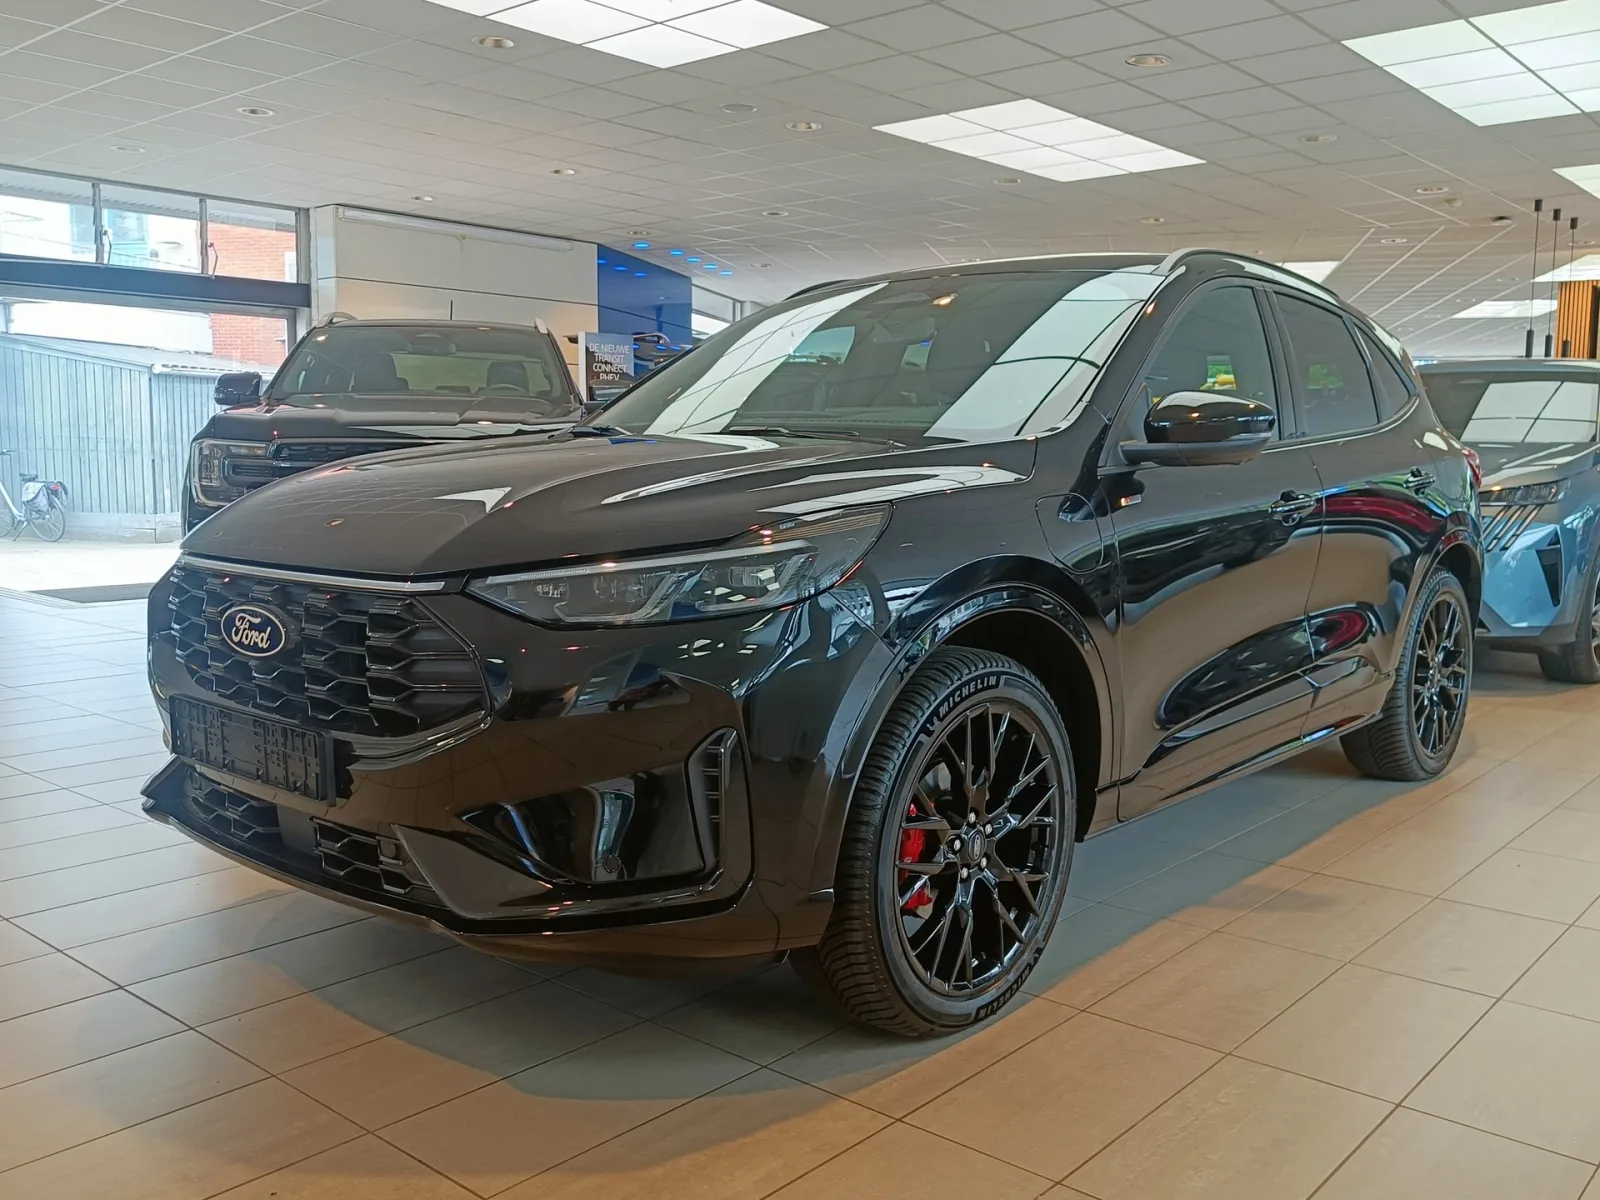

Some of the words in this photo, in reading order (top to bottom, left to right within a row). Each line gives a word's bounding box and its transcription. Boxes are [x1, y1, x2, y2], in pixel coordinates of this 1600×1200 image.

[589, 342, 600, 352] DE
[601, 343, 630, 354] NIEUWE
[594, 353, 625, 363] TRANSIT
[593, 363, 628, 373] CONNECT
[231, 612, 271, 649] Ford
[938, 675, 997, 719] MICHELIN
